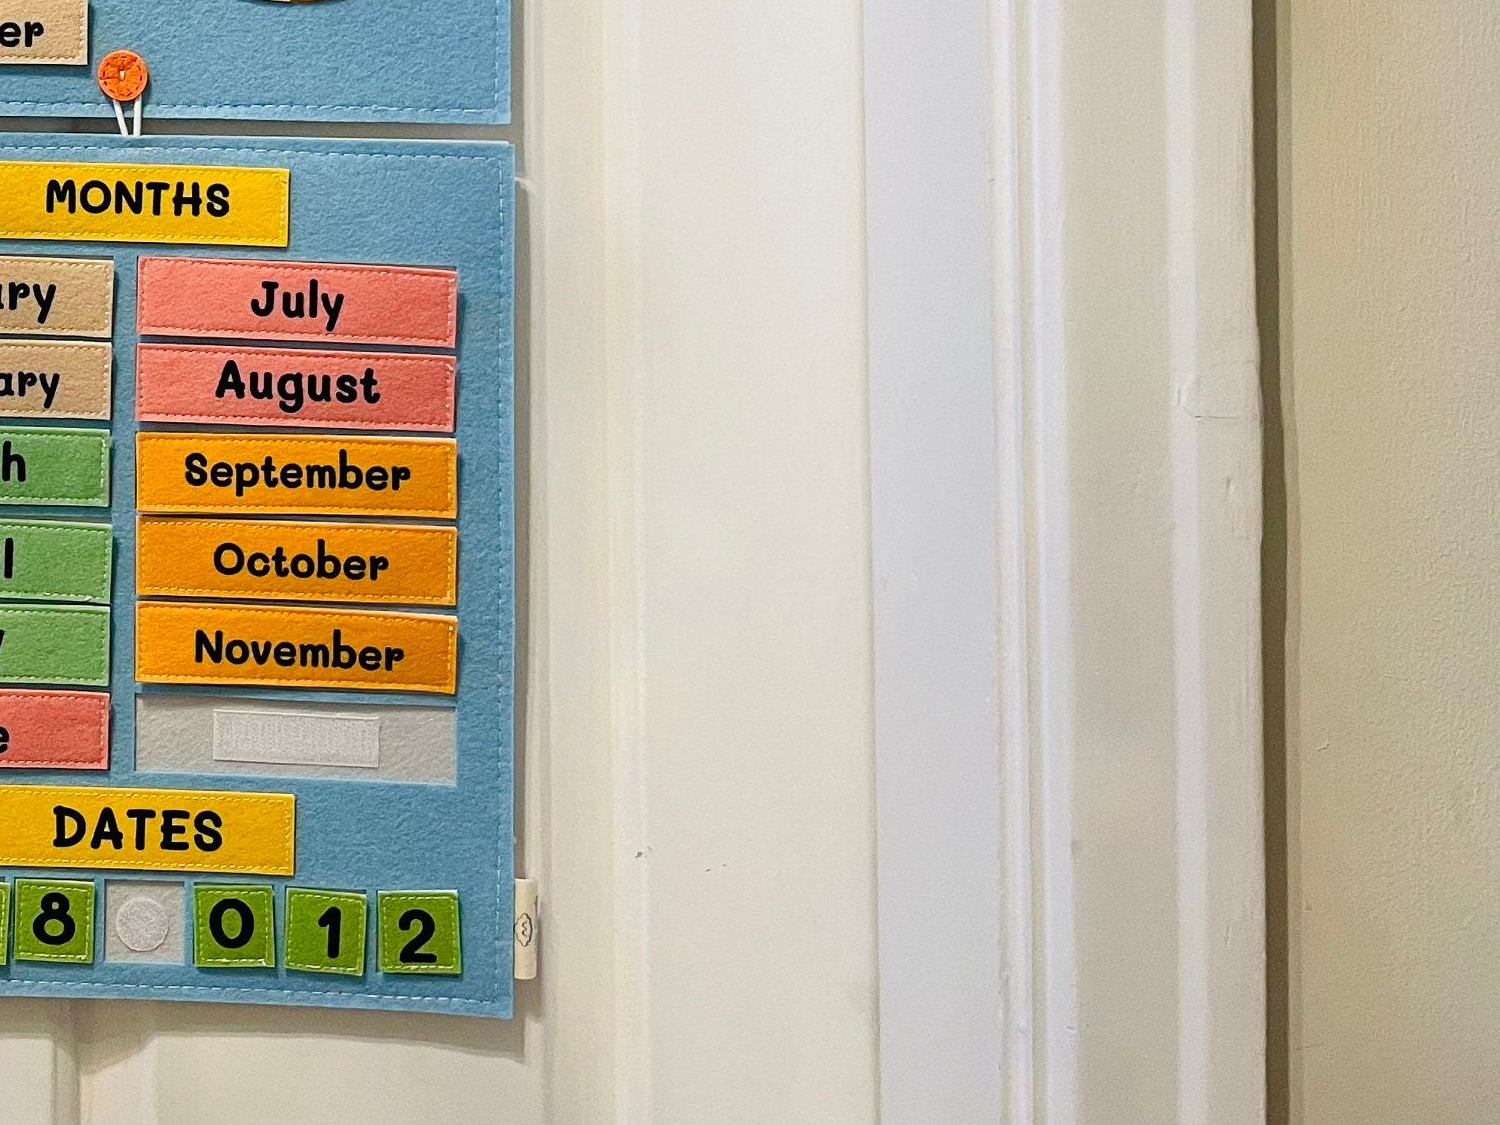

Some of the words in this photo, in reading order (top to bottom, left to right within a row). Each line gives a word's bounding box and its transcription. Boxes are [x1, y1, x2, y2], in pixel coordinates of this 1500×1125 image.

[46, 180, 229, 217] MONTHS
[251, 279, 344, 332] July
[216, 360, 380, 413] August
[185, 449, 410, 497] September
[214, 539, 389, 580] October
[196, 629, 404, 671] November
[53, 806, 222, 852] DATES
[33, 893, 75, 945] 8
[209, 899, 254, 948] 0
[318, 907, 341, 958] 1
[399, 909, 437, 963] 2
